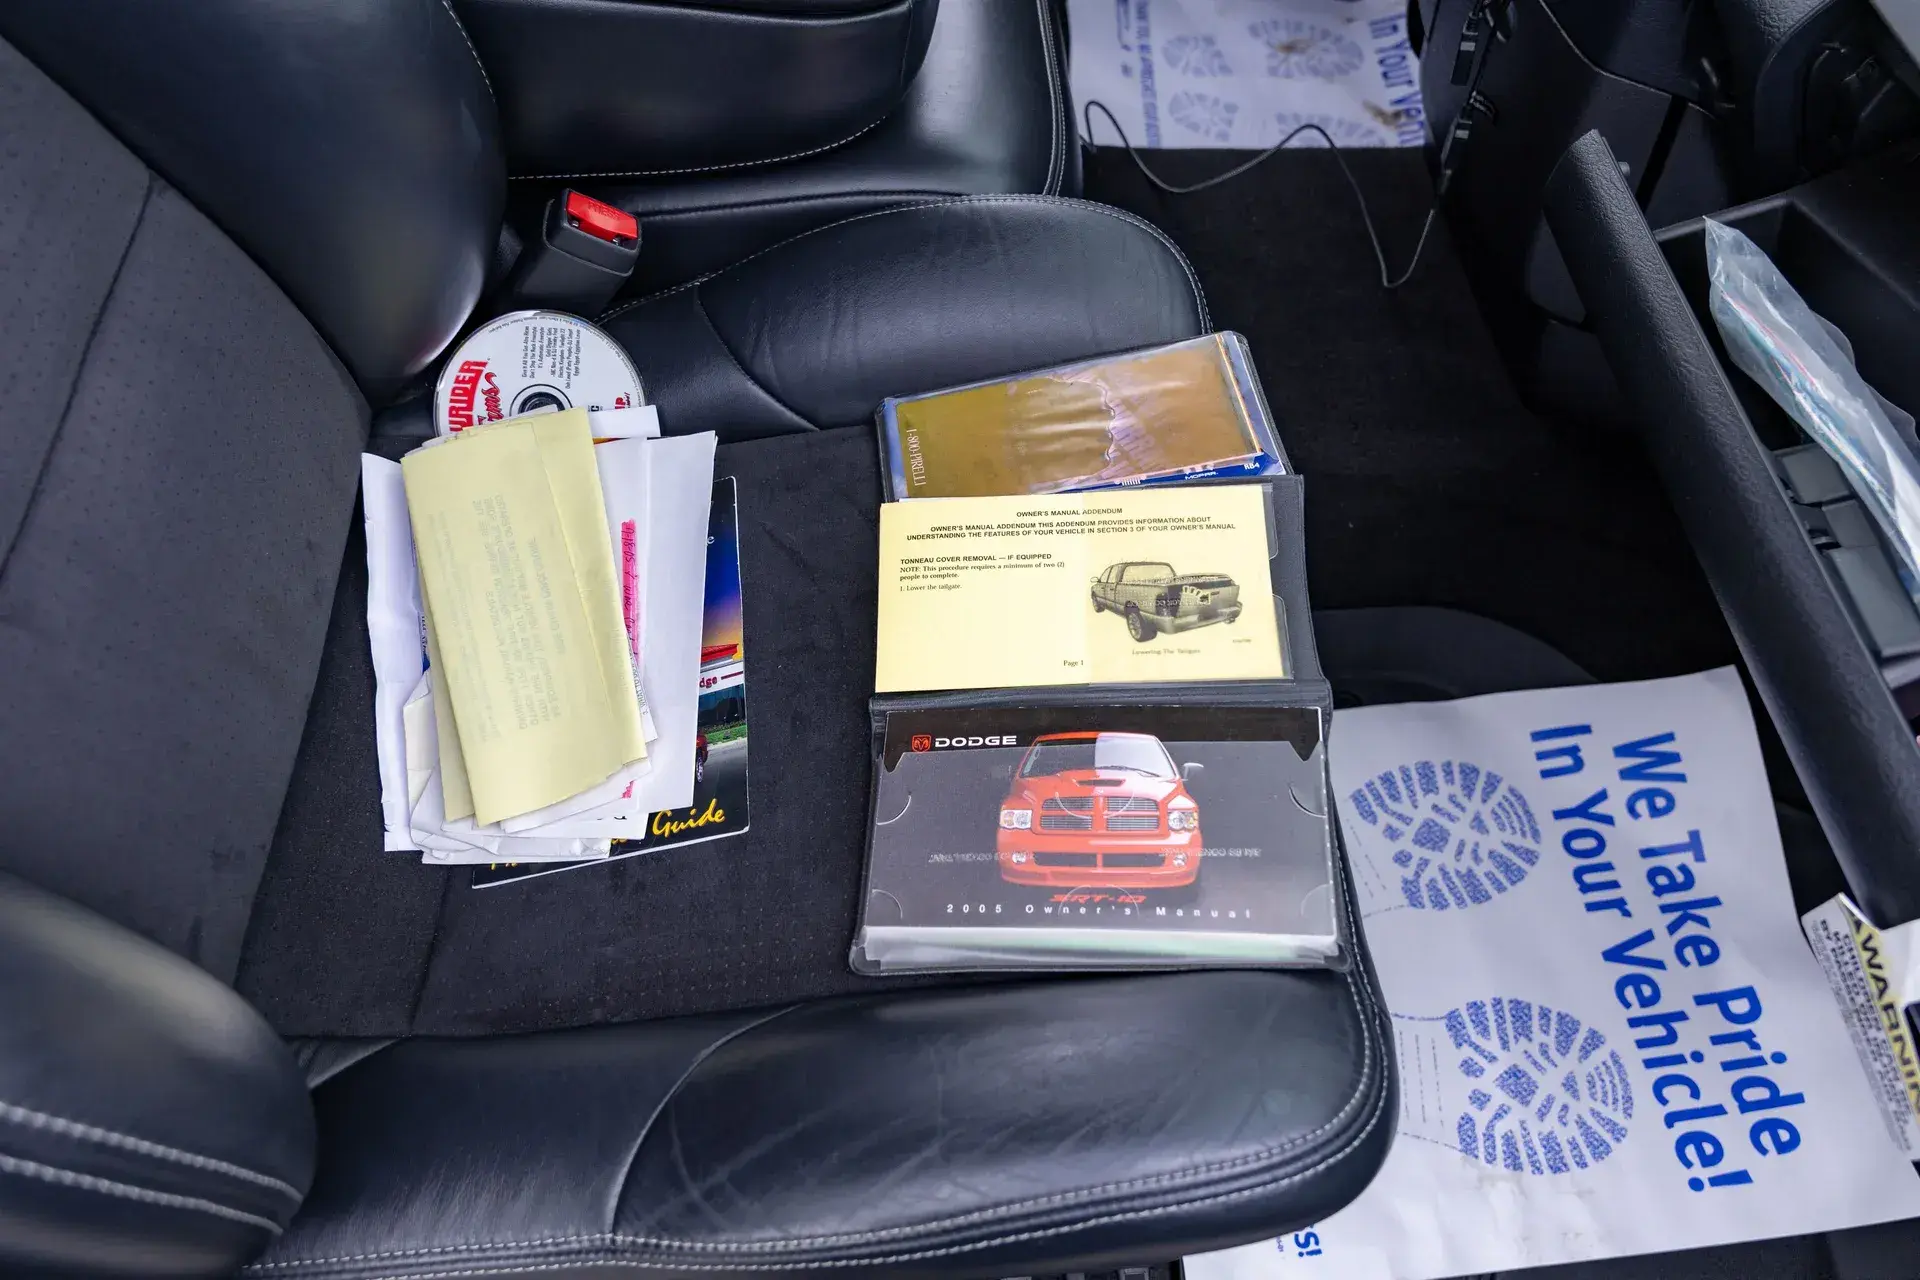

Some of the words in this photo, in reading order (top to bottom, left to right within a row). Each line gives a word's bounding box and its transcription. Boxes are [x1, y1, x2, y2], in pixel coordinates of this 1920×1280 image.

[1375, 39, 1413, 88] Your
[906, 428, 927, 486] 1-800-PIRELLI
[907, 532, 966, 541] UNDERSTANDING
[1055, 528, 1086, 536] VEHICLE
[996, 522, 1036, 530] ADDENDUM
[1056, 520, 1096, 528] ADDENDUM
[1098, 518, 1134, 526] PROVIDES
[900, 557, 934, 565] TONNEAU
[900, 566, 922, 574] NOTE:
[938, 564, 969, 572] procedure
[900, 573, 920, 581] people
[930, 572, 960, 580] complete.
[938, 583, 962, 591] tailgate.
[934, 735, 1017, 748] DODGE
[1529, 723, 1593, 779] In
[1611, 731, 1688, 820] We
[652, 798, 726, 838] Guide
[1552, 787, 1633, 919] Your
[946, 904, 1003, 914] 2005
[1025, 904, 1131, 916] Owner's
[1155, 907, 1251, 919] Manual
[1049, 894, 1147, 904] SRT-10
[1638, 829, 1724, 968] Take
[1601, 928, 1754, 1192] Vehicle!
[1693, 984, 1806, 1157] Pride
